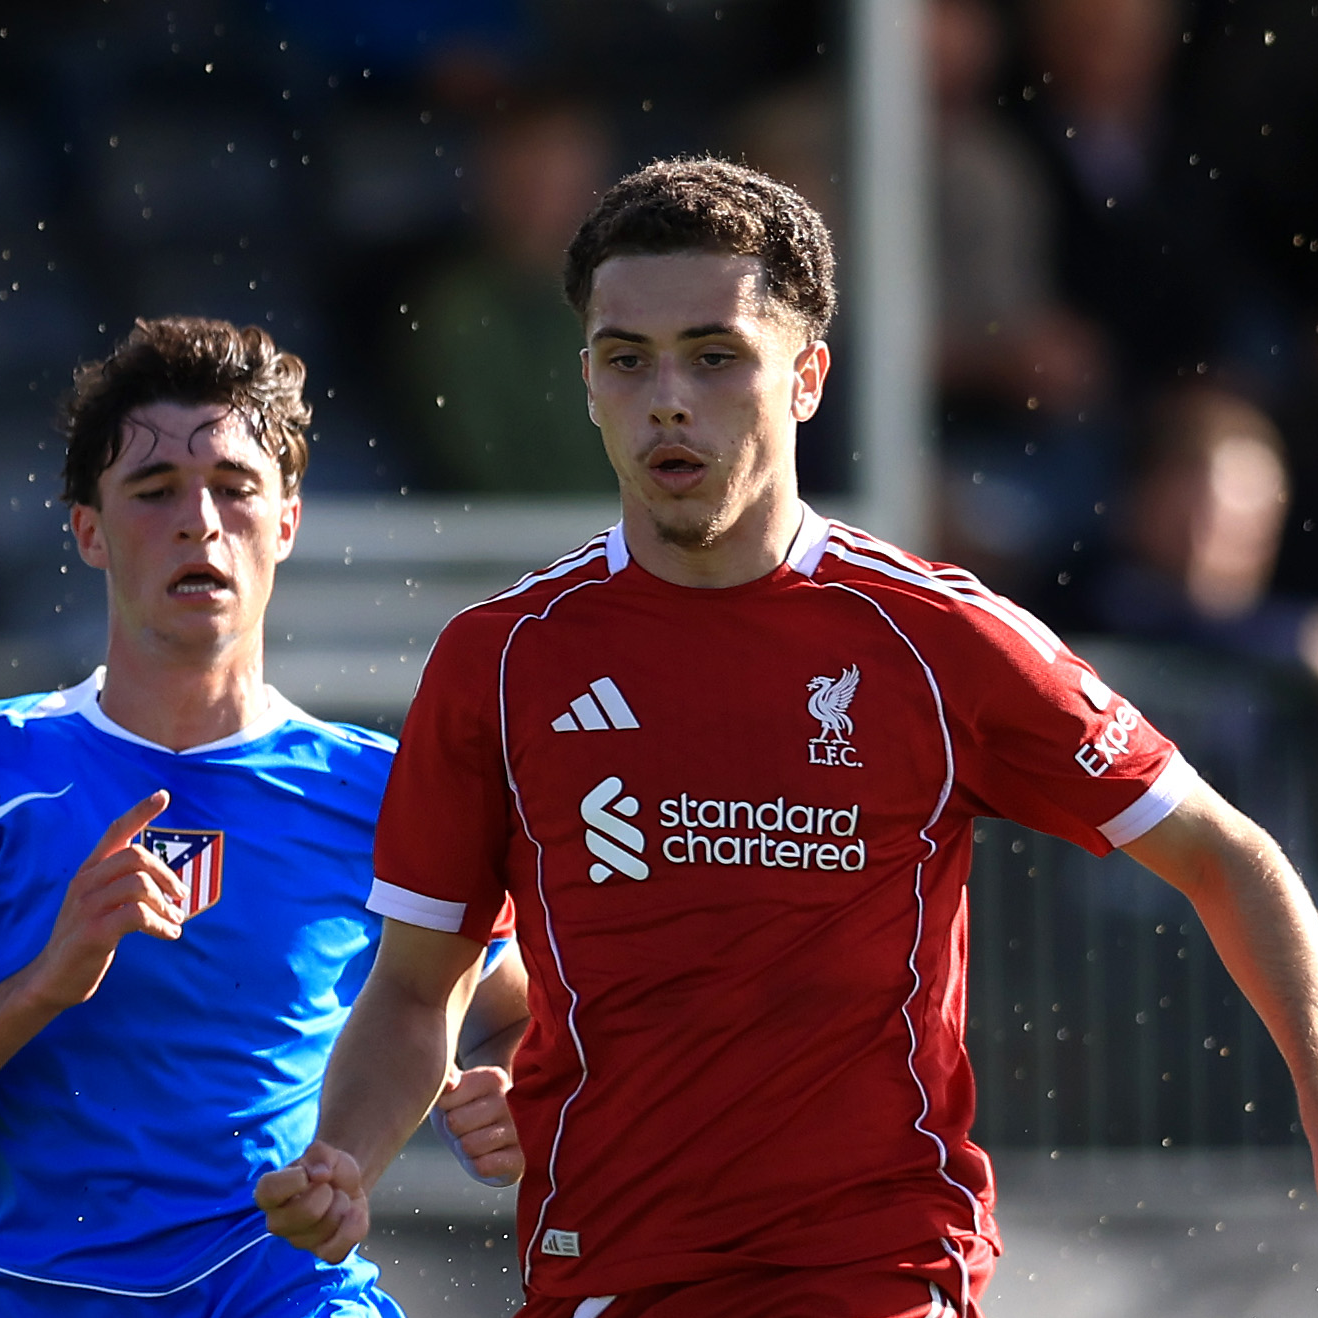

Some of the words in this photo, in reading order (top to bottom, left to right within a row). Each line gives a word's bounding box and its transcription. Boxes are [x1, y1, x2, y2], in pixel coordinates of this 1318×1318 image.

[807, 744, 863, 768] L.F.C.
[659, 792, 859, 837] standard
[662, 829, 866, 872] chartered
